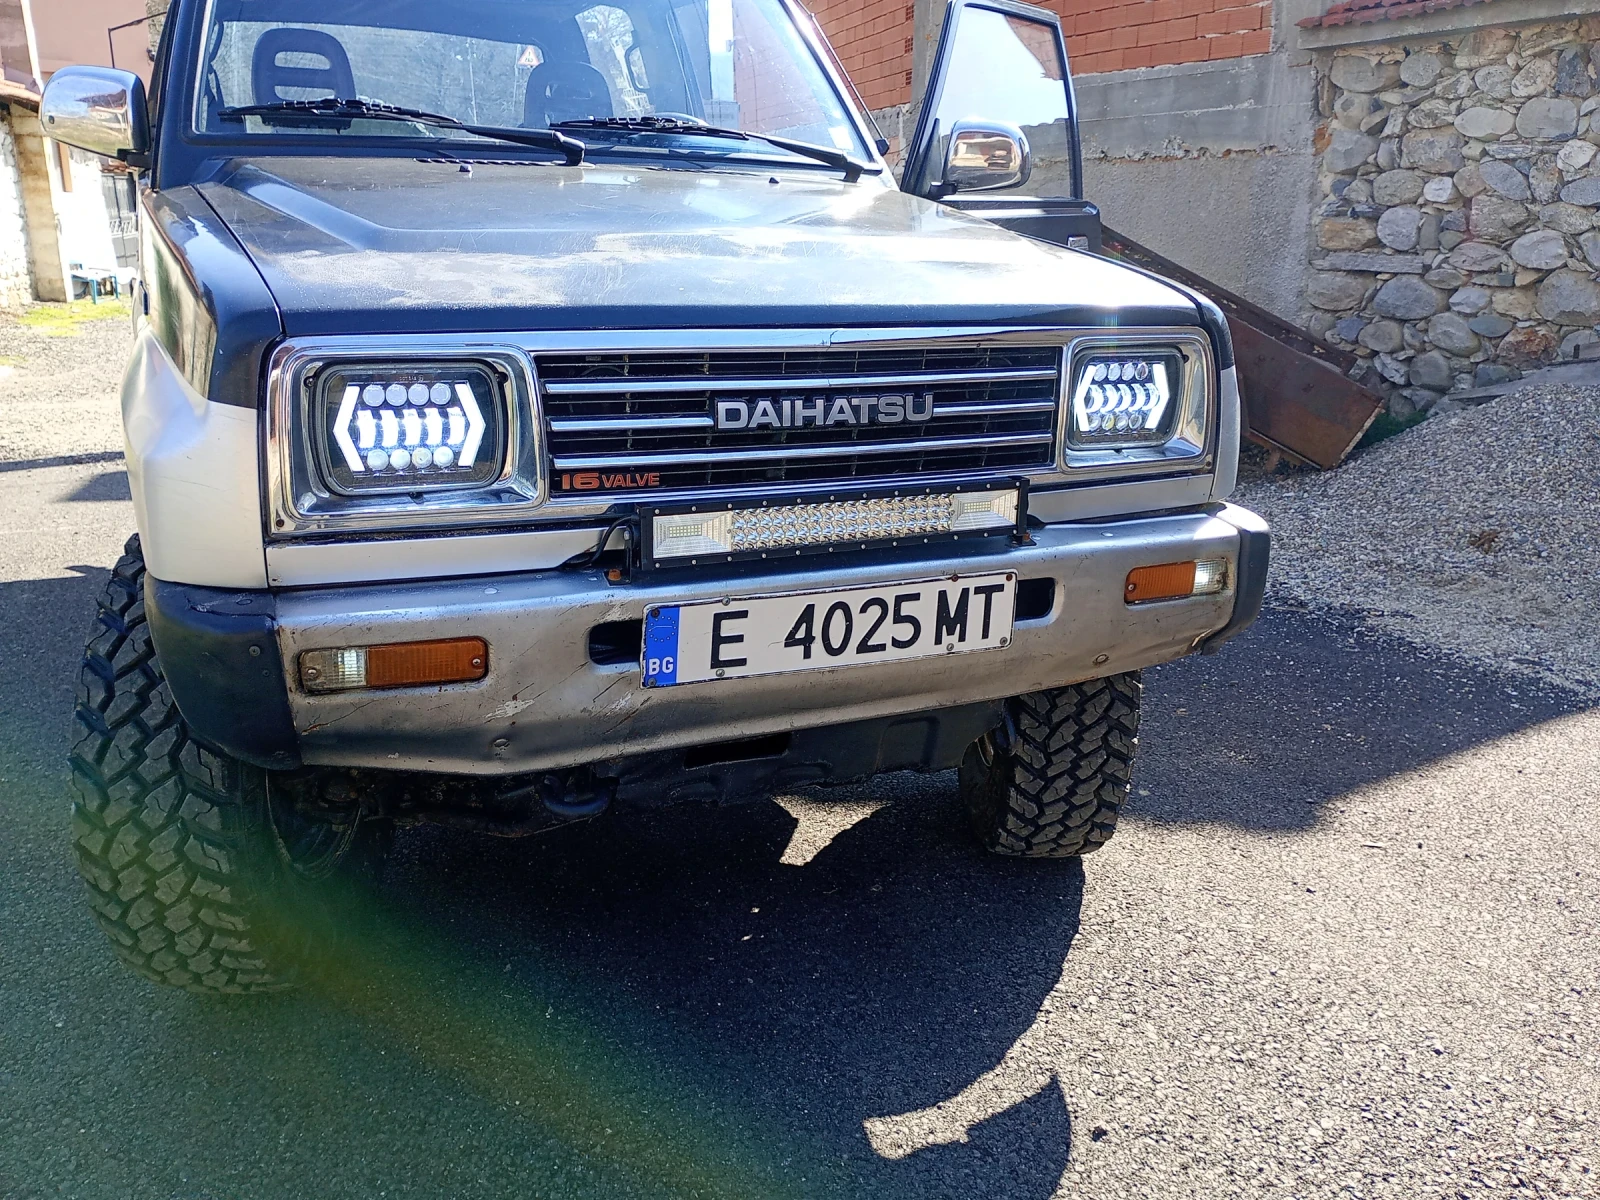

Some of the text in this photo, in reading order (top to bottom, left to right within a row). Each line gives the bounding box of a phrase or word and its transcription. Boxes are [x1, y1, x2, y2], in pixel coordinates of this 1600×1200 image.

[716, 393, 934, 430] DAIHATSU
[561, 472, 660, 490] 16 VALVE
[710, 583, 1005, 670] E 4025 MT
[648, 656, 674, 675] BG
